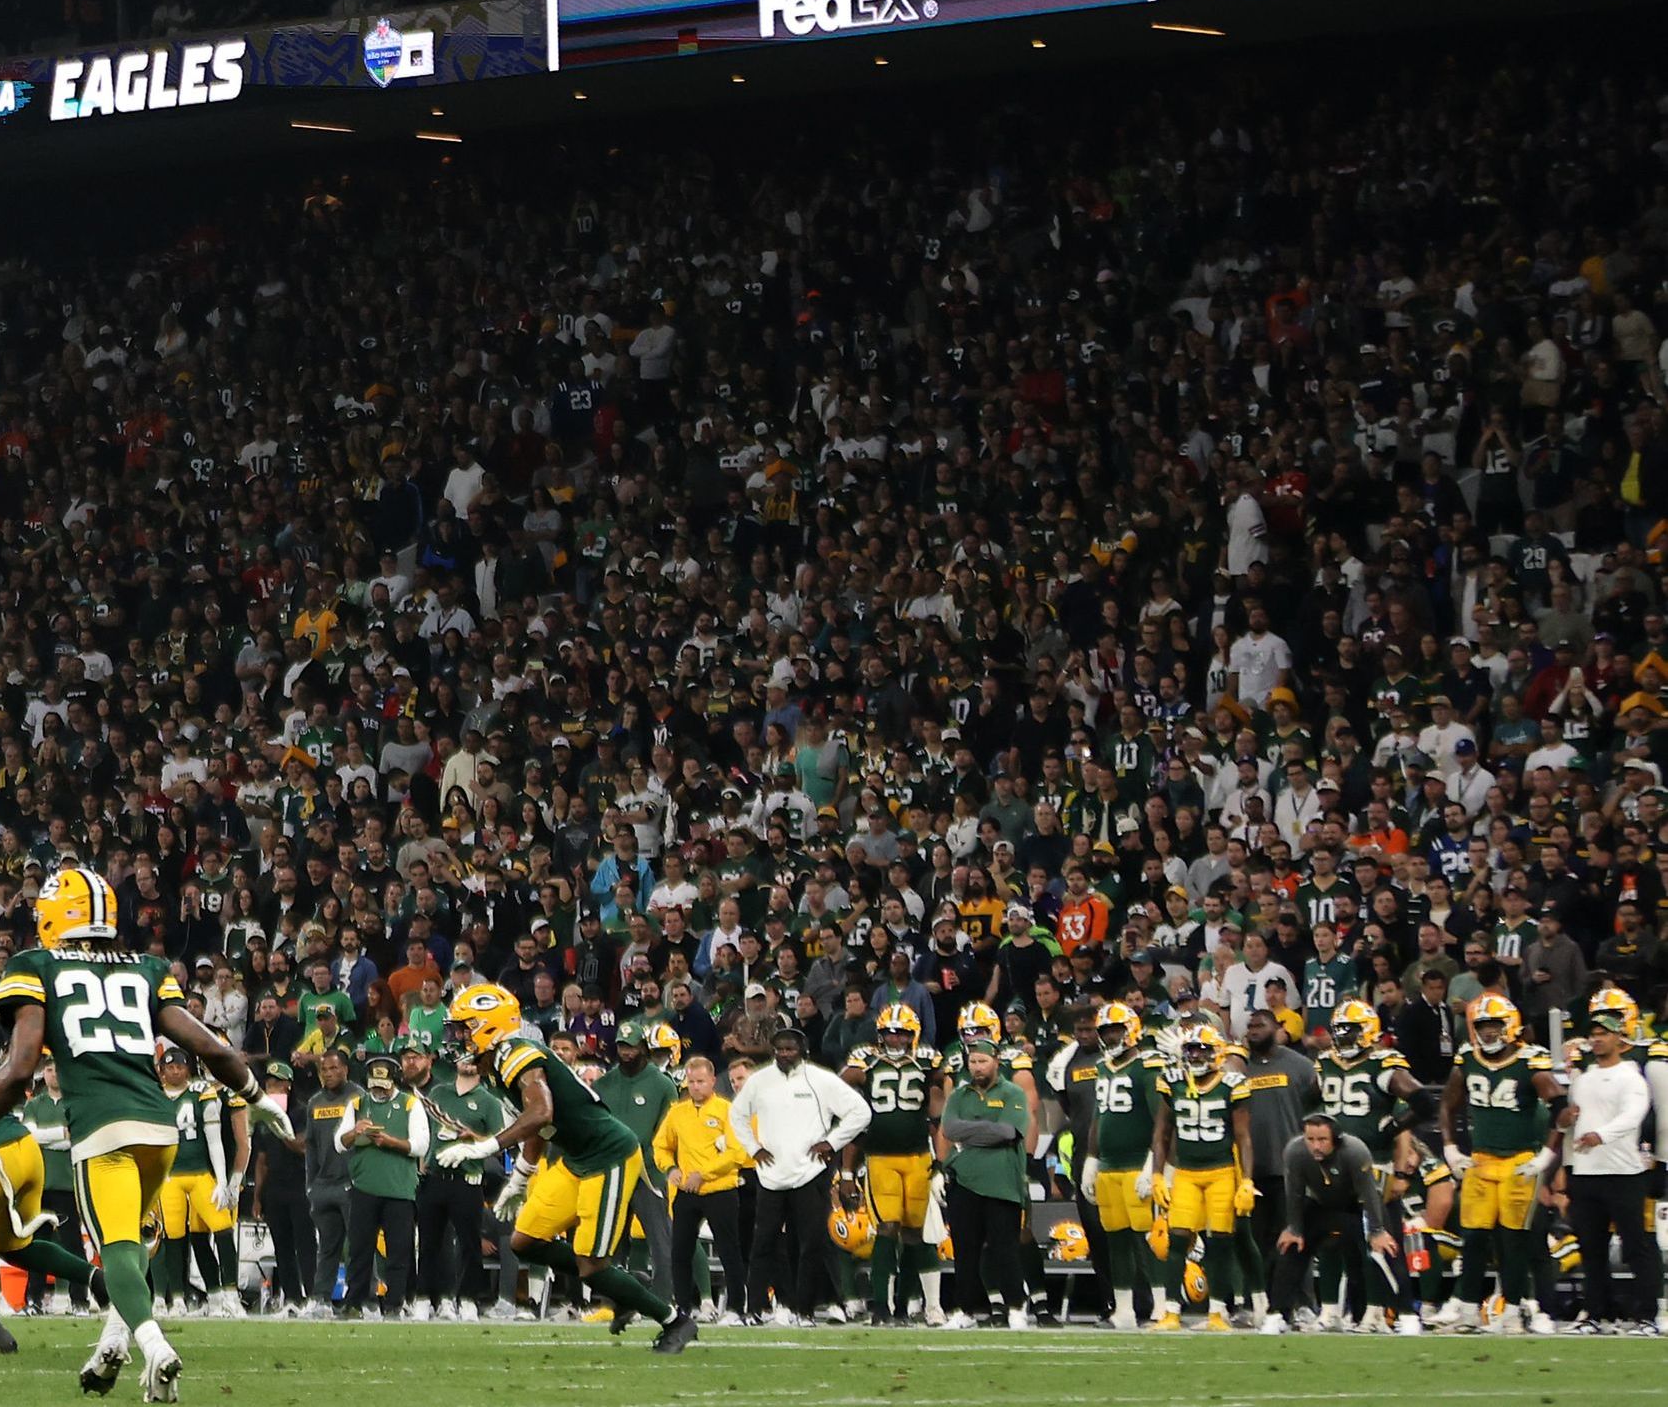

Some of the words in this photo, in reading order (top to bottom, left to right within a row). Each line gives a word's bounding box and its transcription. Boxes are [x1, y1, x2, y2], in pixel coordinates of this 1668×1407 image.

[50, 41, 248, 123] EAGLES
[570, 390, 592, 410] 23
[1522, 547, 1547, 571] 29
[1062, 916, 1087, 941] 33
[1308, 899, 1334, 928] 10
[1497, 936, 1521, 958] 10
[1244, 983, 1258, 1011] 1
[1307, 978, 1334, 1008] 26
[54, 969, 156, 1057] 29
[870, 1072, 925, 1113] 55
[1097, 1078, 1133, 1112] 96
[1321, 1074, 1371, 1117] 95
[1467, 1075, 1521, 1112] 84
[176, 1103, 197, 1140] 4
[1174, 1099, 1228, 1142] 25
